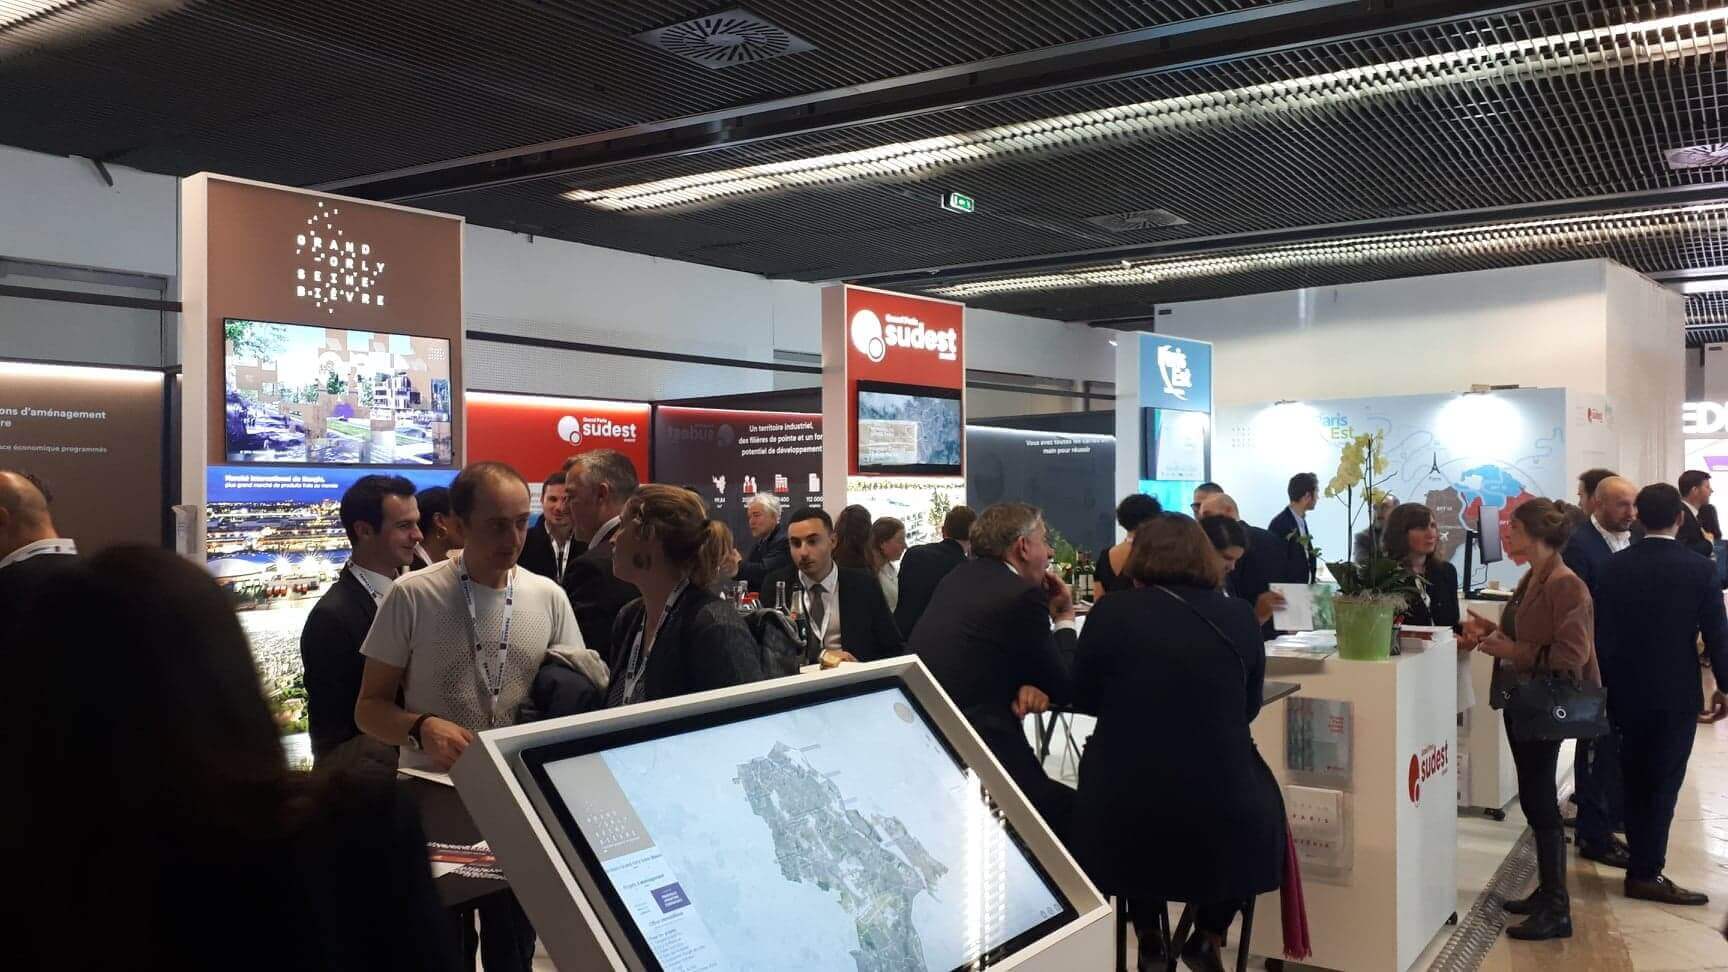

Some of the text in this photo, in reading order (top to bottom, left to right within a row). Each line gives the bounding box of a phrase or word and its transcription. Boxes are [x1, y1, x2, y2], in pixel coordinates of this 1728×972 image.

[297, 234, 370, 255] GRAND
[329, 256, 385, 273] ORLY
[297, 268, 369, 288] SEINE
[885, 322, 957, 353] sudest
[582, 420, 636, 438] sudest
[749, 425, 758, 433] Un
[759, 423, 783, 432] territoire
[1331, 426, 1354, 439] Est
[738, 437, 749, 445] des
[769, 435, 777, 443] de
[778, 434, 797, 445] pointe
[741, 444, 823, 456] potentiel de développement
[1057, 447, 1071, 455] pour
[1421, 739, 1448, 783] sudest
